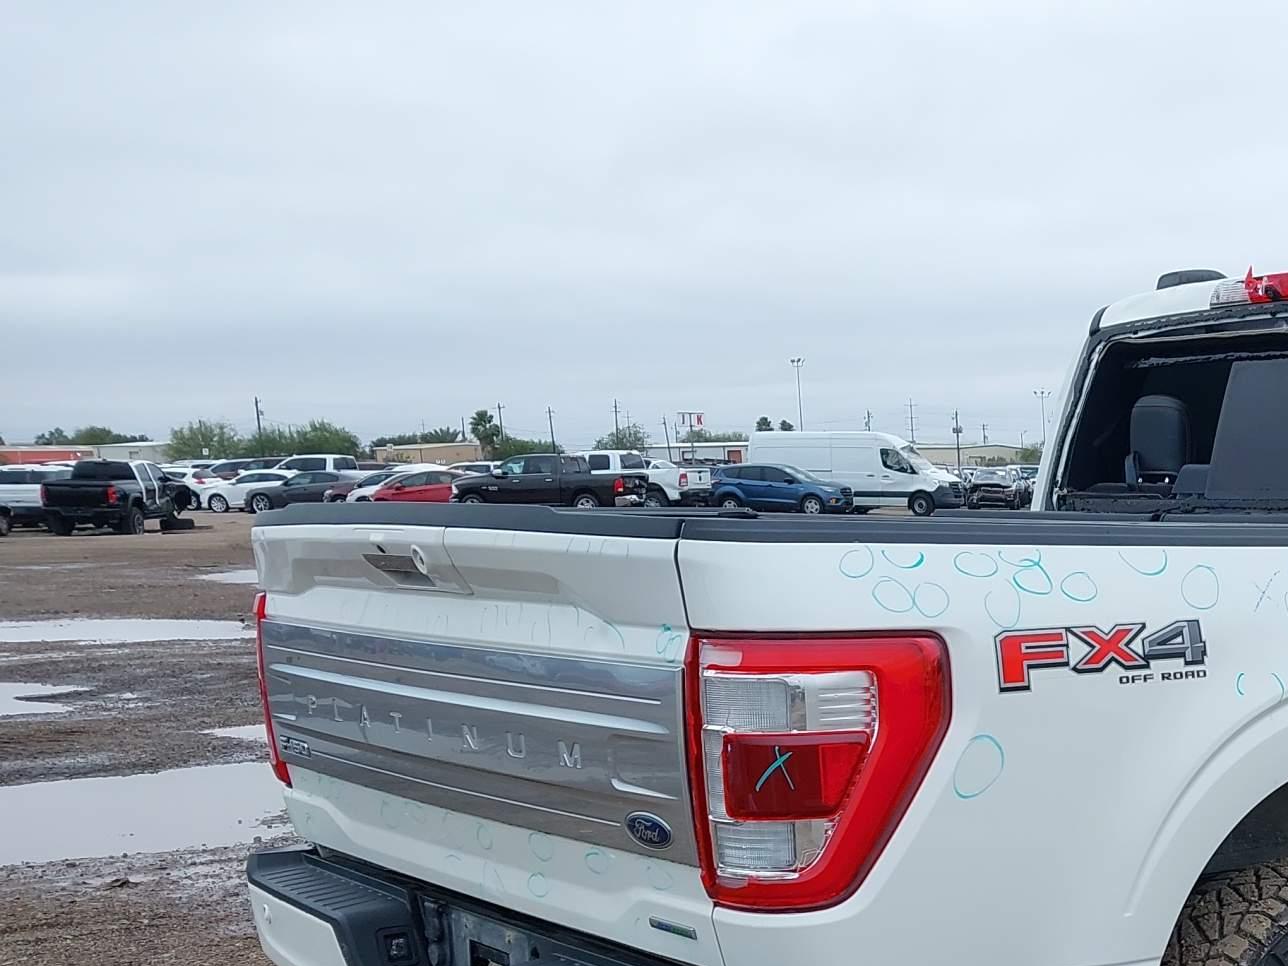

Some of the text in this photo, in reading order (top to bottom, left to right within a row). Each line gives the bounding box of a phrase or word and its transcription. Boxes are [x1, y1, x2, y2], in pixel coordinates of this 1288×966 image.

[994, 619, 1208, 692] FX4
[1119, 669, 1207, 684] OFF ROAD
[306, 695, 583, 769] PLATINUM
[633, 818, 660, 843] Ford
